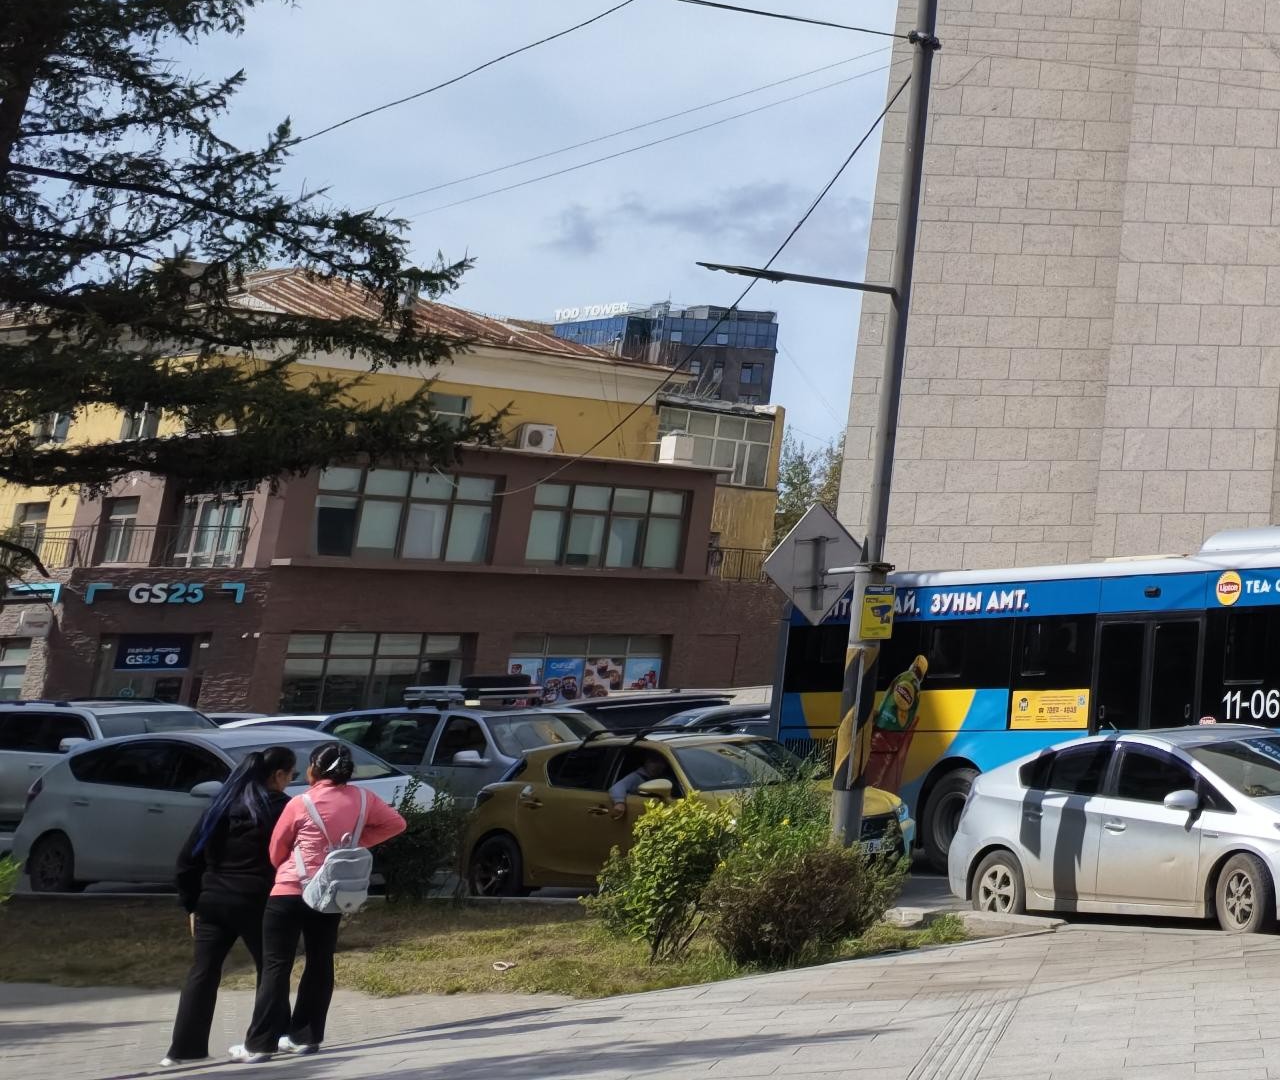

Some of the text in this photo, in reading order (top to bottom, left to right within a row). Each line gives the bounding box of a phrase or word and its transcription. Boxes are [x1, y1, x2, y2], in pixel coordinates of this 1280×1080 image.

[554, 302, 629, 320] TOD TOWER
[129, 582, 205, 604] GS25
[1219, 583, 1239, 593] Lipton
[1245, 579, 1272, 594] TEA
[930, 591, 982, 613] ЗУНЫ
[986, 589, 1030, 611] АМТ.
[125, 654, 160, 665] GS25
